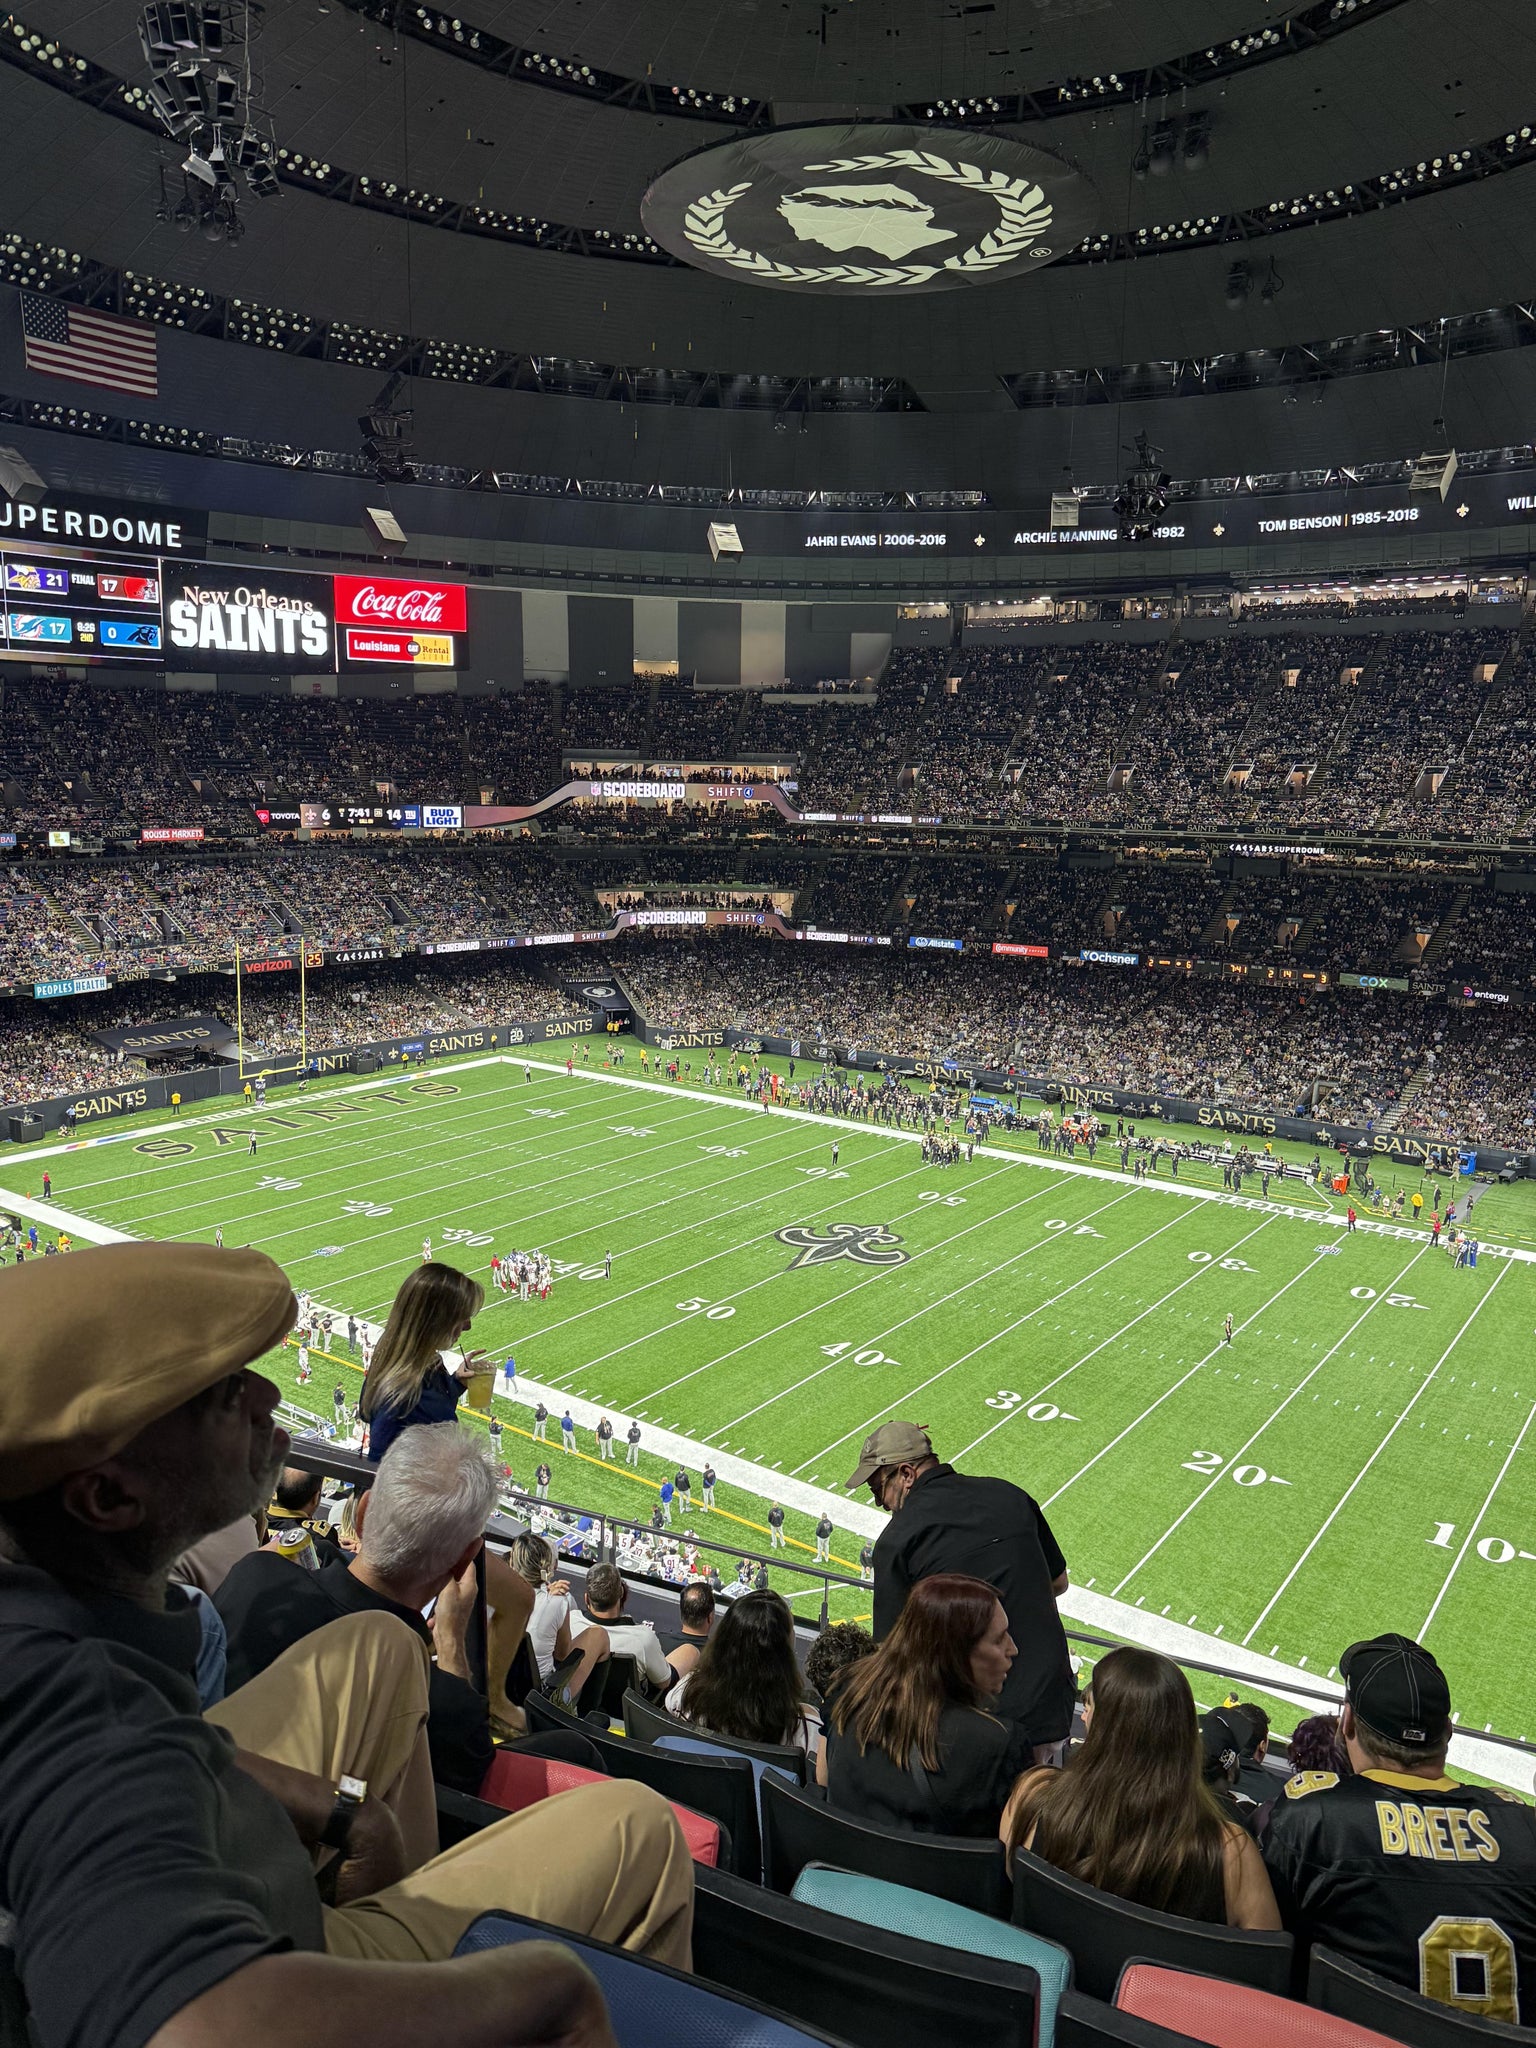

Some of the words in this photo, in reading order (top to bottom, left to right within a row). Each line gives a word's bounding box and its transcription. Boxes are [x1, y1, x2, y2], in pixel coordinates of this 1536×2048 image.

[1258, 520, 1287, 533] TOM
[1289, 515, 1342, 531] BENSON
[1350, 508, 1419, 526] 1985-2018
[804, 535, 838, 547] JAHRI
[840, 534, 877, 547] EVANS
[884, 533, 947, 546] 2006-2016
[1014, 532, 1057, 544] ARCHIE
[1059, 529, 1118, 543] MANNING
[46, 573, 62, 587] 21
[71, 573, 96, 586] FINAL
[101, 579, 118, 592] 17
[182, 586, 230, 607] New
[234, 586, 314, 616] Orleans
[352, 586, 448, 623] Coca-Cola
[49, 622, 66, 635] 17
[107, 627, 117, 639] 0
[169, 599, 328, 656] SAINTS
[354, 639, 400, 653] Louisiana
[422, 645, 449, 655] Rental
[603, 782, 685, 799] SCOREBOARD
[270, 812, 300, 820] TOYOTA
[321, 808, 331, 821] 6
[347, 808, 370, 818] 7:41
[386, 809, 402, 821] 14
[430, 808, 455, 817] BUD
[425, 817, 459, 826] LIGHT
[948, 817, 974, 825] SAINTS
[1004, 819, 1032, 827] SAINTS
[1062, 820, 1091, 828] SAINTS
[1123, 823, 1153, 831] SAINTS
[1186, 824, 1218, 832] SAINTS
[100, 829, 132, 839] SAINTS
[143, 829, 170, 839] ROUSES
[171, 828, 203, 839] MARKETS
[230, 827, 258, 836] SAINTS
[1254, 826, 1287, 835] SAINTS
[1324, 828, 1358, 837] SAINTS
[1397, 831, 1432, 841] SAINTS
[1473, 835, 1510, 845] SAINTS
[1229, 843, 1274, 853] CAESARS
[1274, 845, 1326, 855] SUPERDOME
[637, 910, 707, 925] SCOREBOARD
[534, 933, 575, 946] SCOREBOARD
[806, 931, 848, 943] SCOREBOARD
[436, 940, 480, 954] SCOREBOARD
[307, 953, 322, 966] 25
[335, 949, 384, 962] CAESARS
[1089, 951, 1137, 965] Ochsner
[188, 963, 219, 974] SAINTS
[245, 959, 293, 974] verizon
[117, 970, 150, 982] SAINTS
[1359, 976, 1388, 988] COX
[36, 982, 73, 997] PEOPLES
[75, 977, 105, 992] HEALTH
[1412, 980, 1446, 992] SAINTS
[1474, 989, 1510, 1004] entergy
[545, 1018, 593, 1038] SAINTS
[123, 1026, 211, 1048] SAINTS
[429, 1031, 485, 1054] SAINTS
[668, 1032, 724, 1048] SAINTS
[74, 1087, 148, 1120] SAINTS
[132, 1082, 462, 1160] SAINTS
[676, 1297, 737, 1321] 50
[820, 1341, 886, 1367] 40
[985, 1390, 1060, 1422] 30
[1181, 1451, 1267, 1487] 20
[1425, 1521, 1515, 1564] 10
[1375, 1800, 1501, 1862] BREES
